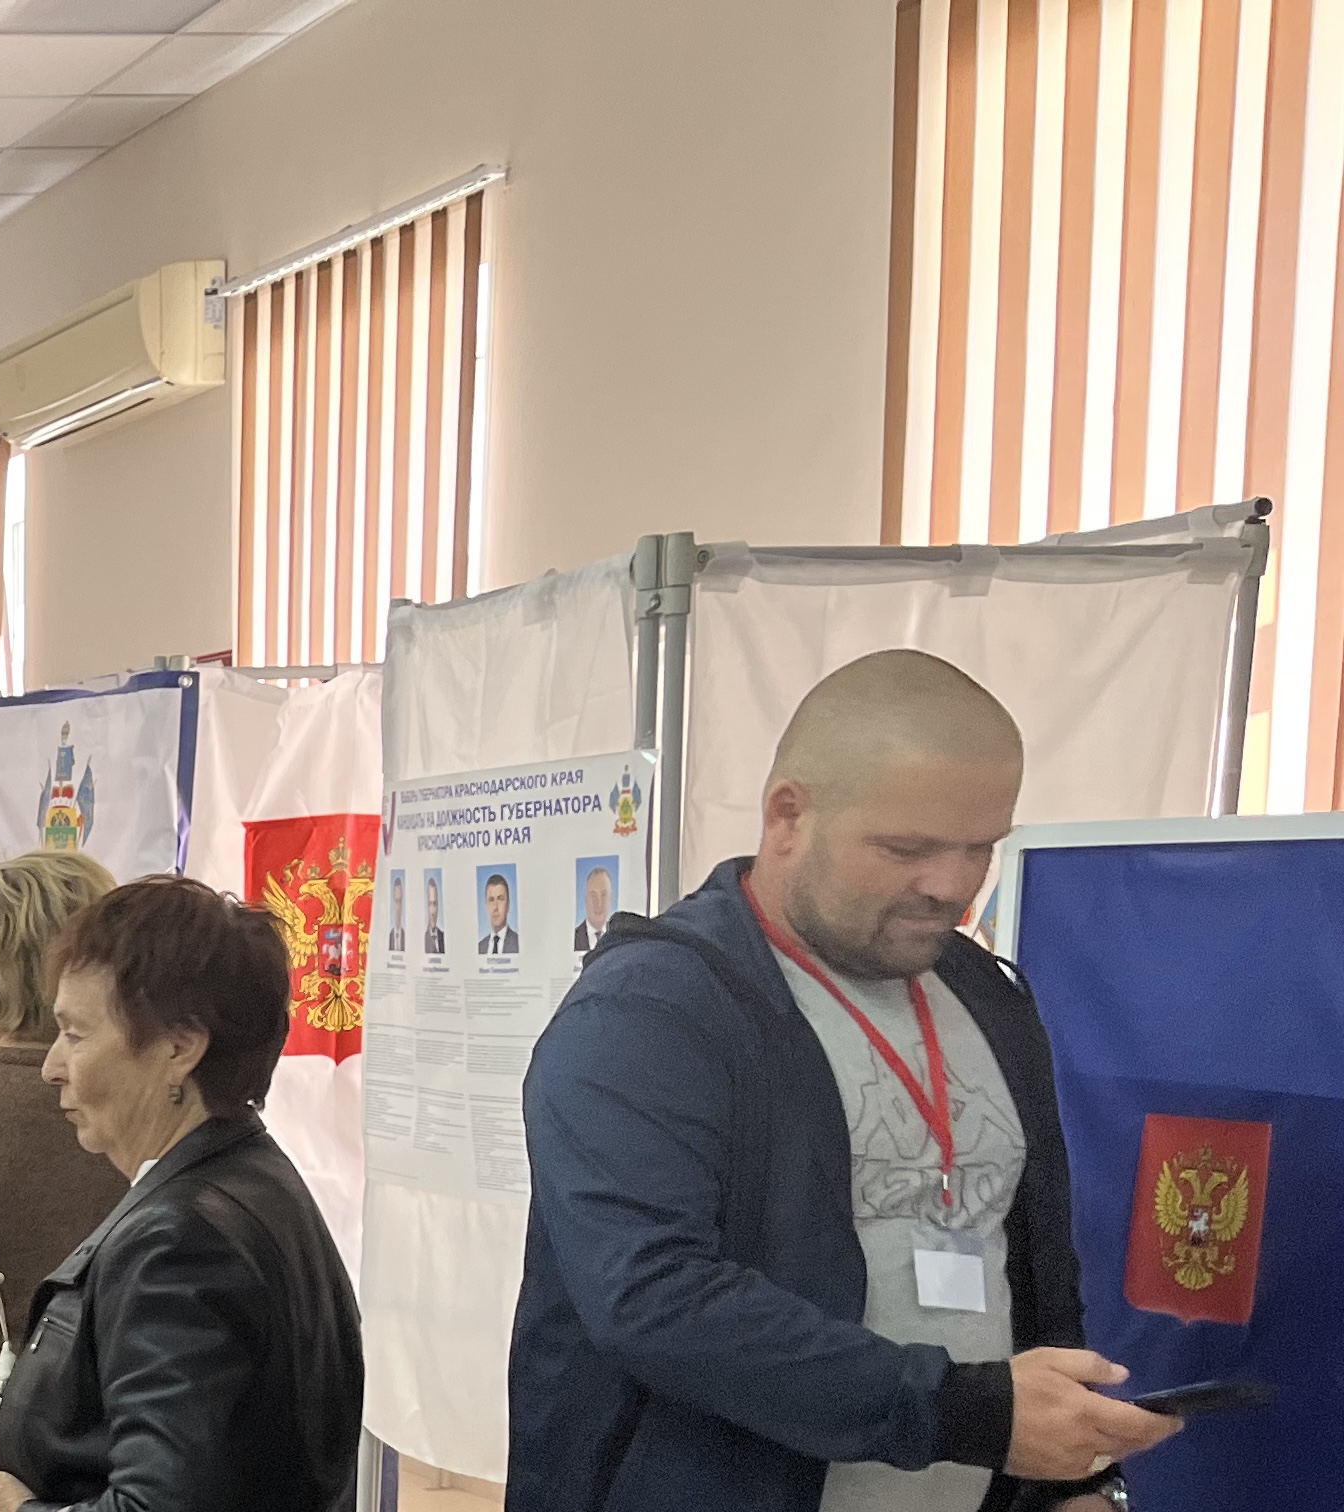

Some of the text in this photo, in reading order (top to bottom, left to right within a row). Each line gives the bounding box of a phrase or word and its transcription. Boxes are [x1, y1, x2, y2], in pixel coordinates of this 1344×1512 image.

[454, 774, 547, 798] КРАСНОДАРСКОГО
[551, 769, 584, 787] КРАЯ
[435, 805, 496, 830] ДОЛЖНОСТЬ
[500, 793, 602, 821] ГУБЕРНАТОРА
[494, 826, 531, 846] КРАЯ
